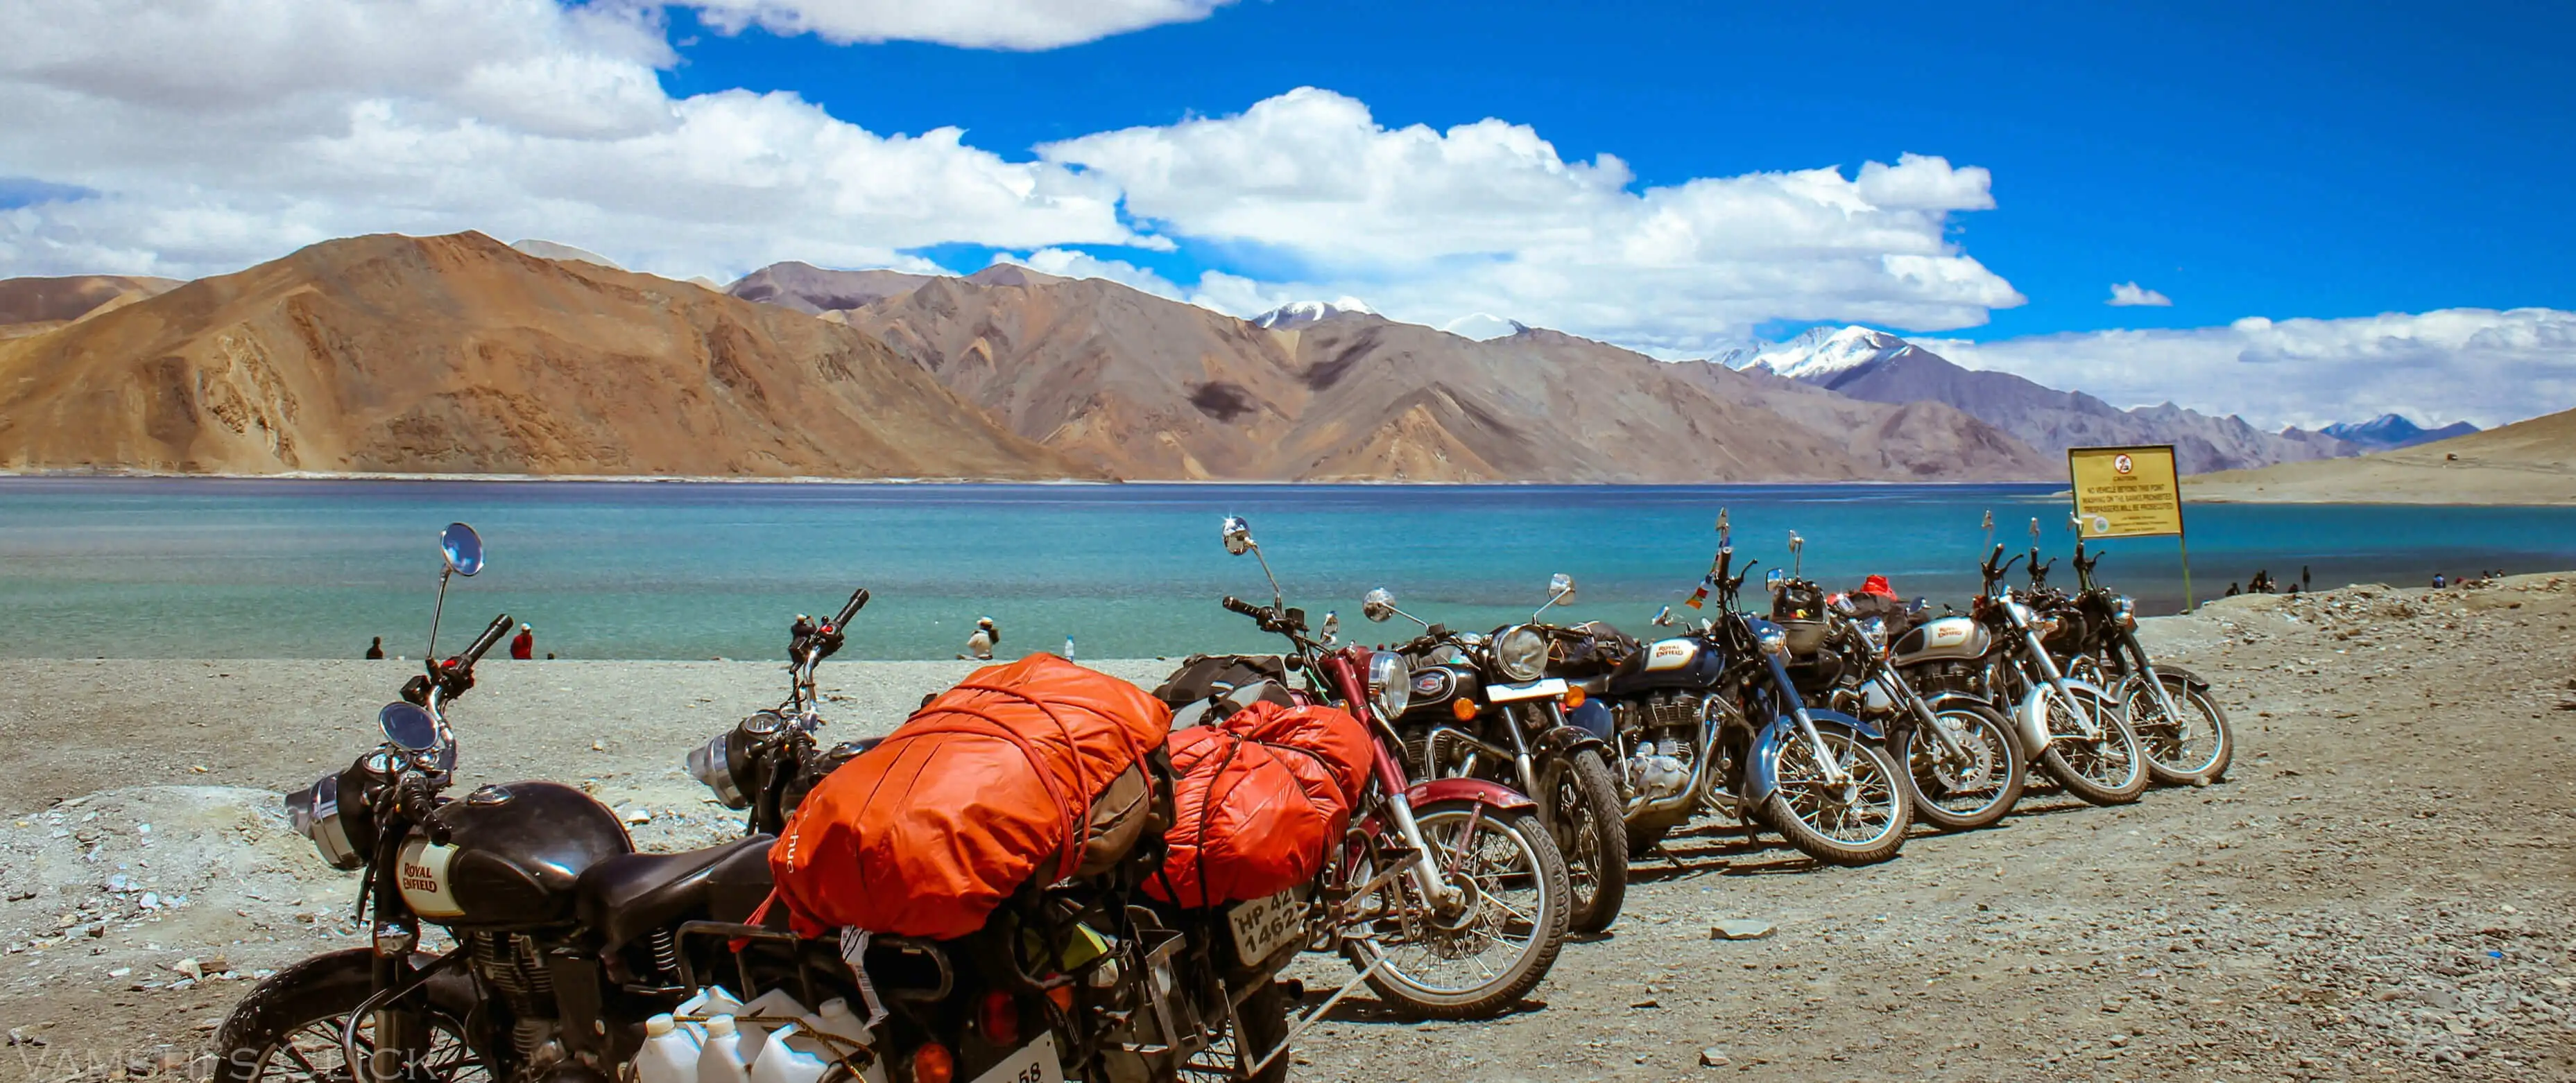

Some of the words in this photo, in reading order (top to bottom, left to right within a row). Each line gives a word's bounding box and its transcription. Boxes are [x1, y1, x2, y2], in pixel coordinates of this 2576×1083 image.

[1656, 649, 1684, 658] ENFIELD
[404, 863, 432, 878] ROYAL
[403, 877, 438, 893] ENFIELD
[1238, 903, 1264, 935] HP
[1271, 890, 1291, 911] 42
[1245, 908, 1297, 953] 1462
